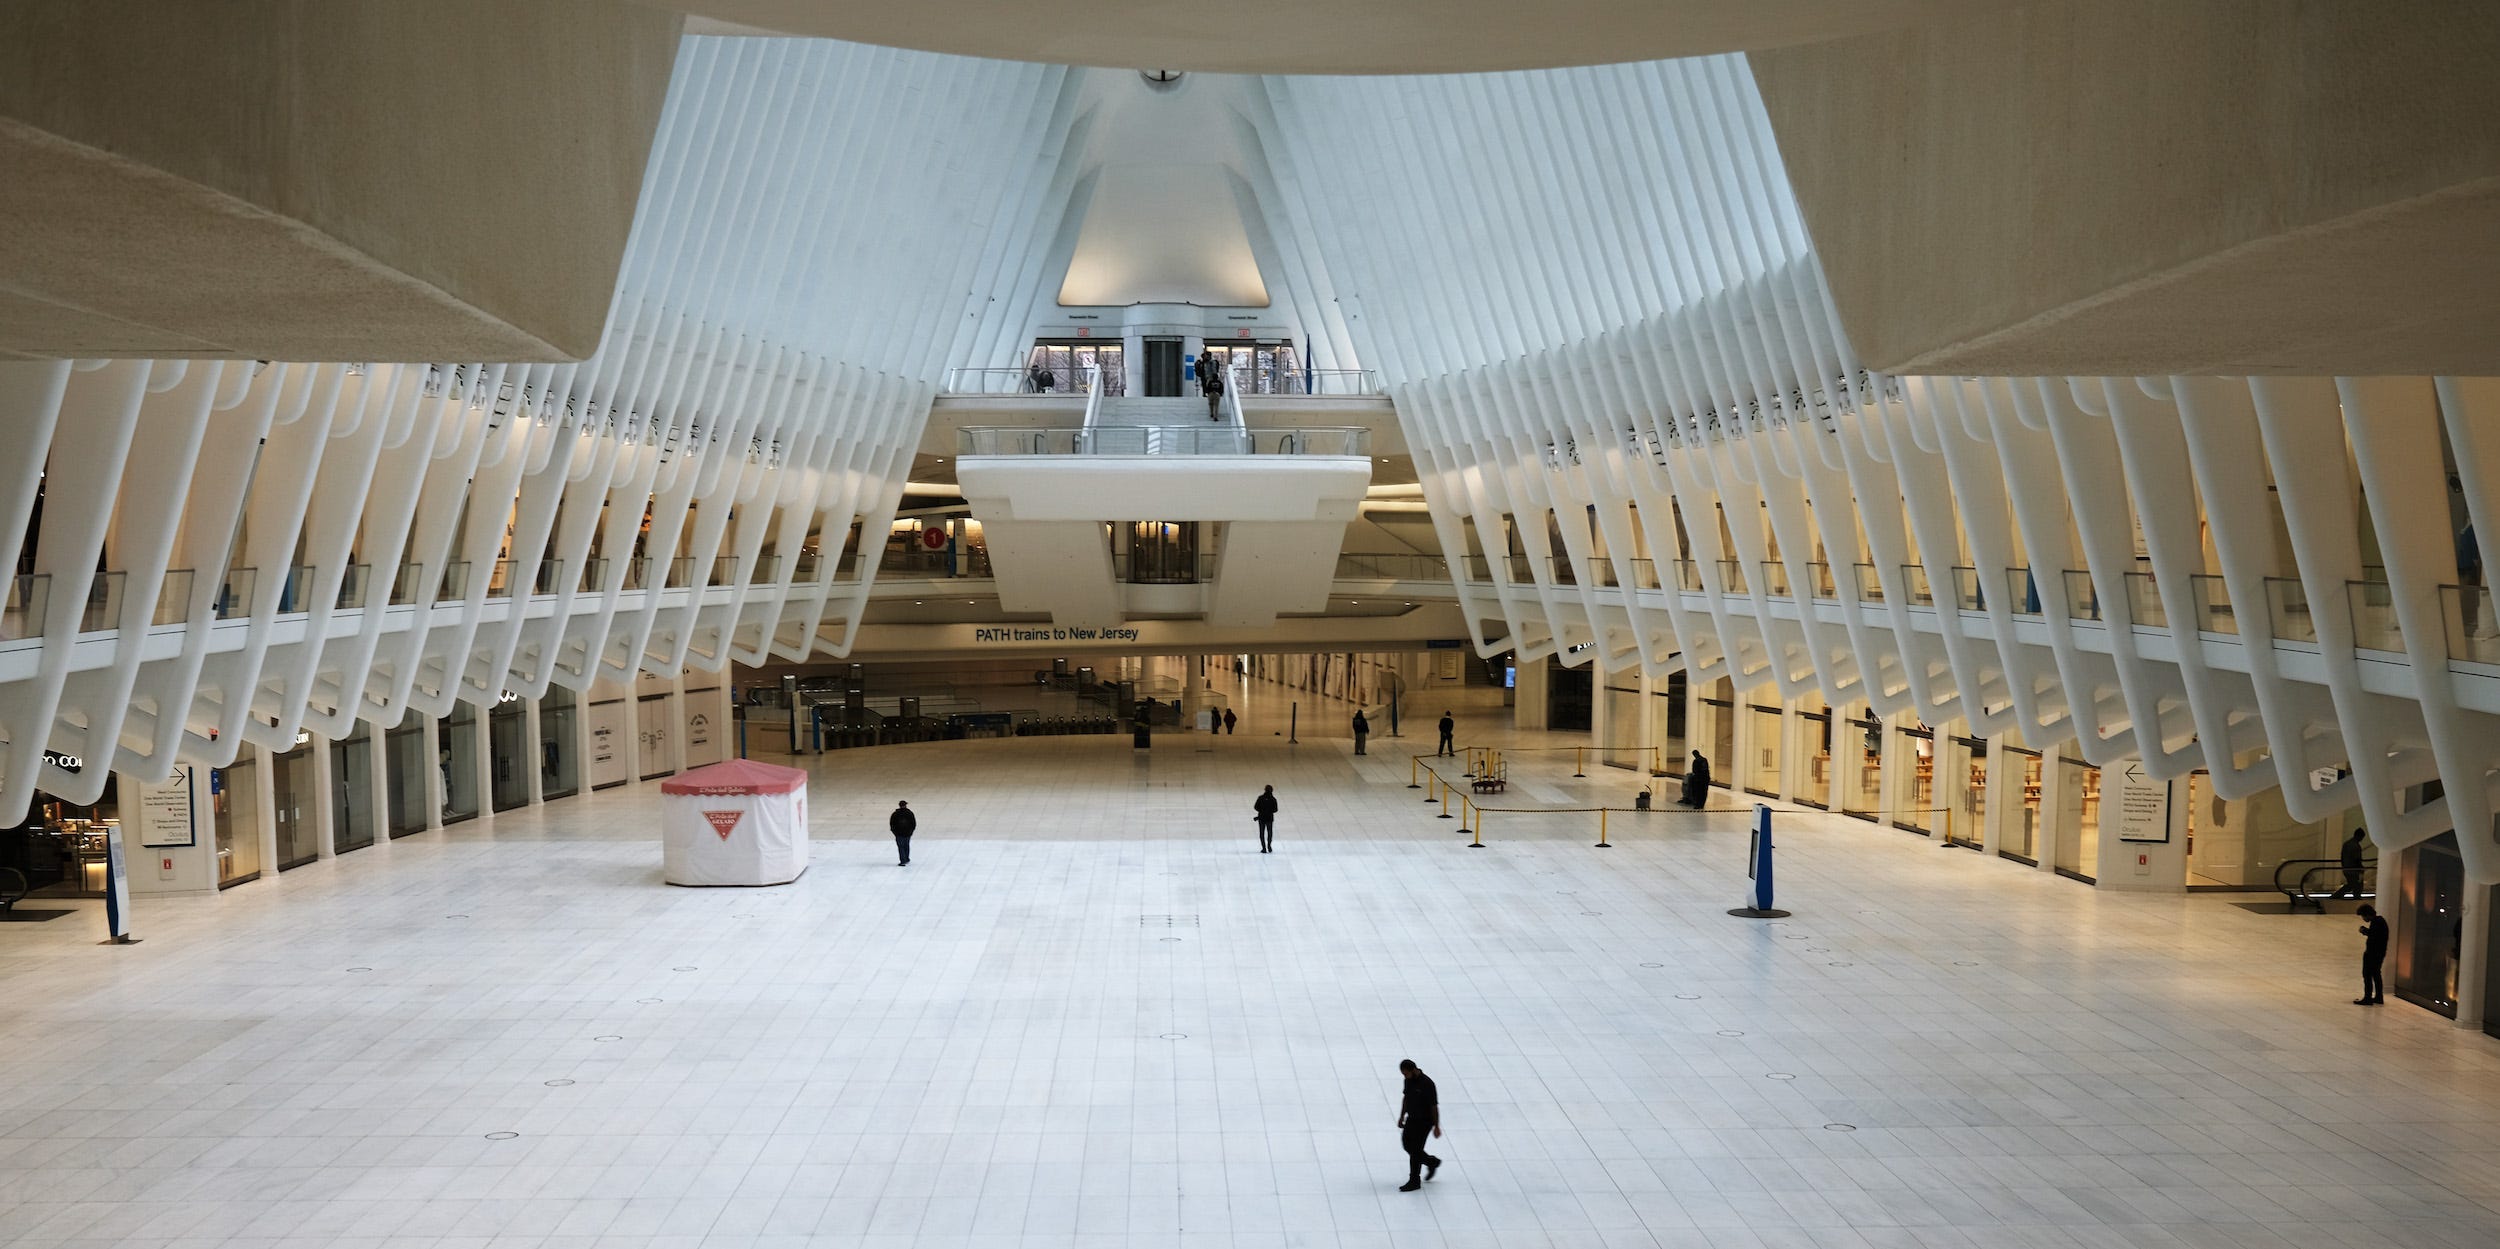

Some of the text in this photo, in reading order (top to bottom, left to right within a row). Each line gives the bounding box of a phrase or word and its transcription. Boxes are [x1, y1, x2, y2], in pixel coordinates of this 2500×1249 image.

[930, 532, 937, 545] 1
[976, 627, 1139, 642] PATH trains to New Jersey
